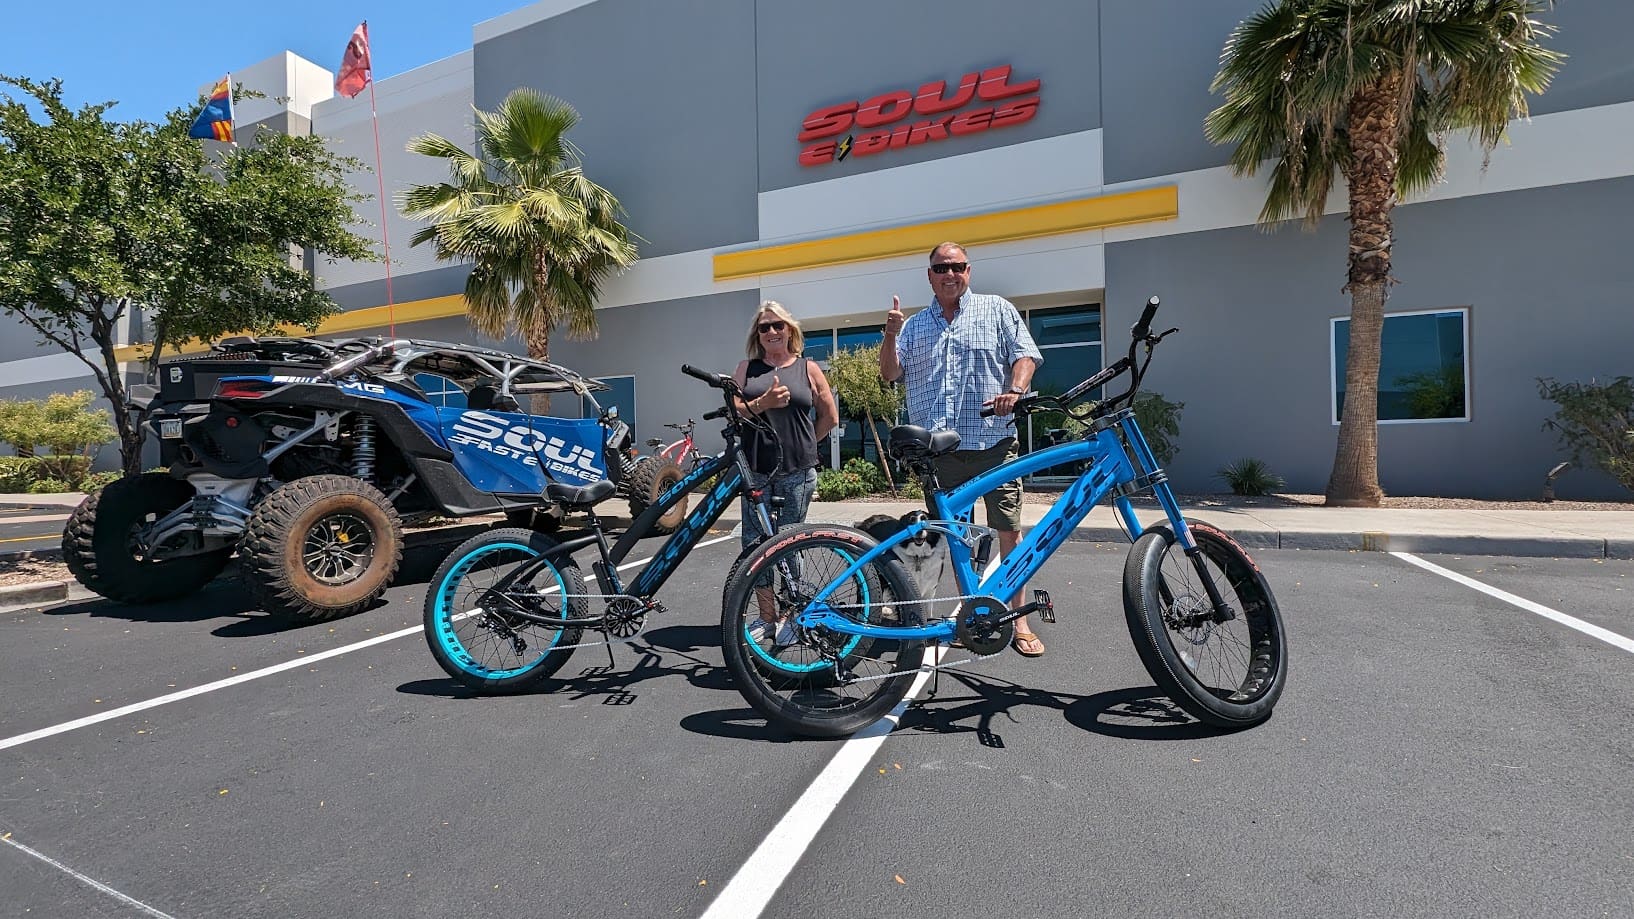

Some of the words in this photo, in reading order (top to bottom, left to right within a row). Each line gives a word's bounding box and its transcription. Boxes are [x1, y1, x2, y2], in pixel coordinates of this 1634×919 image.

[798, 64, 1040, 143] SOUL
[852, 96, 1040, 158] BIKES
[452, 411, 603, 475] SOUL
[639, 473, 742, 591] SOUL
[1005, 460, 1121, 588] SOUL
